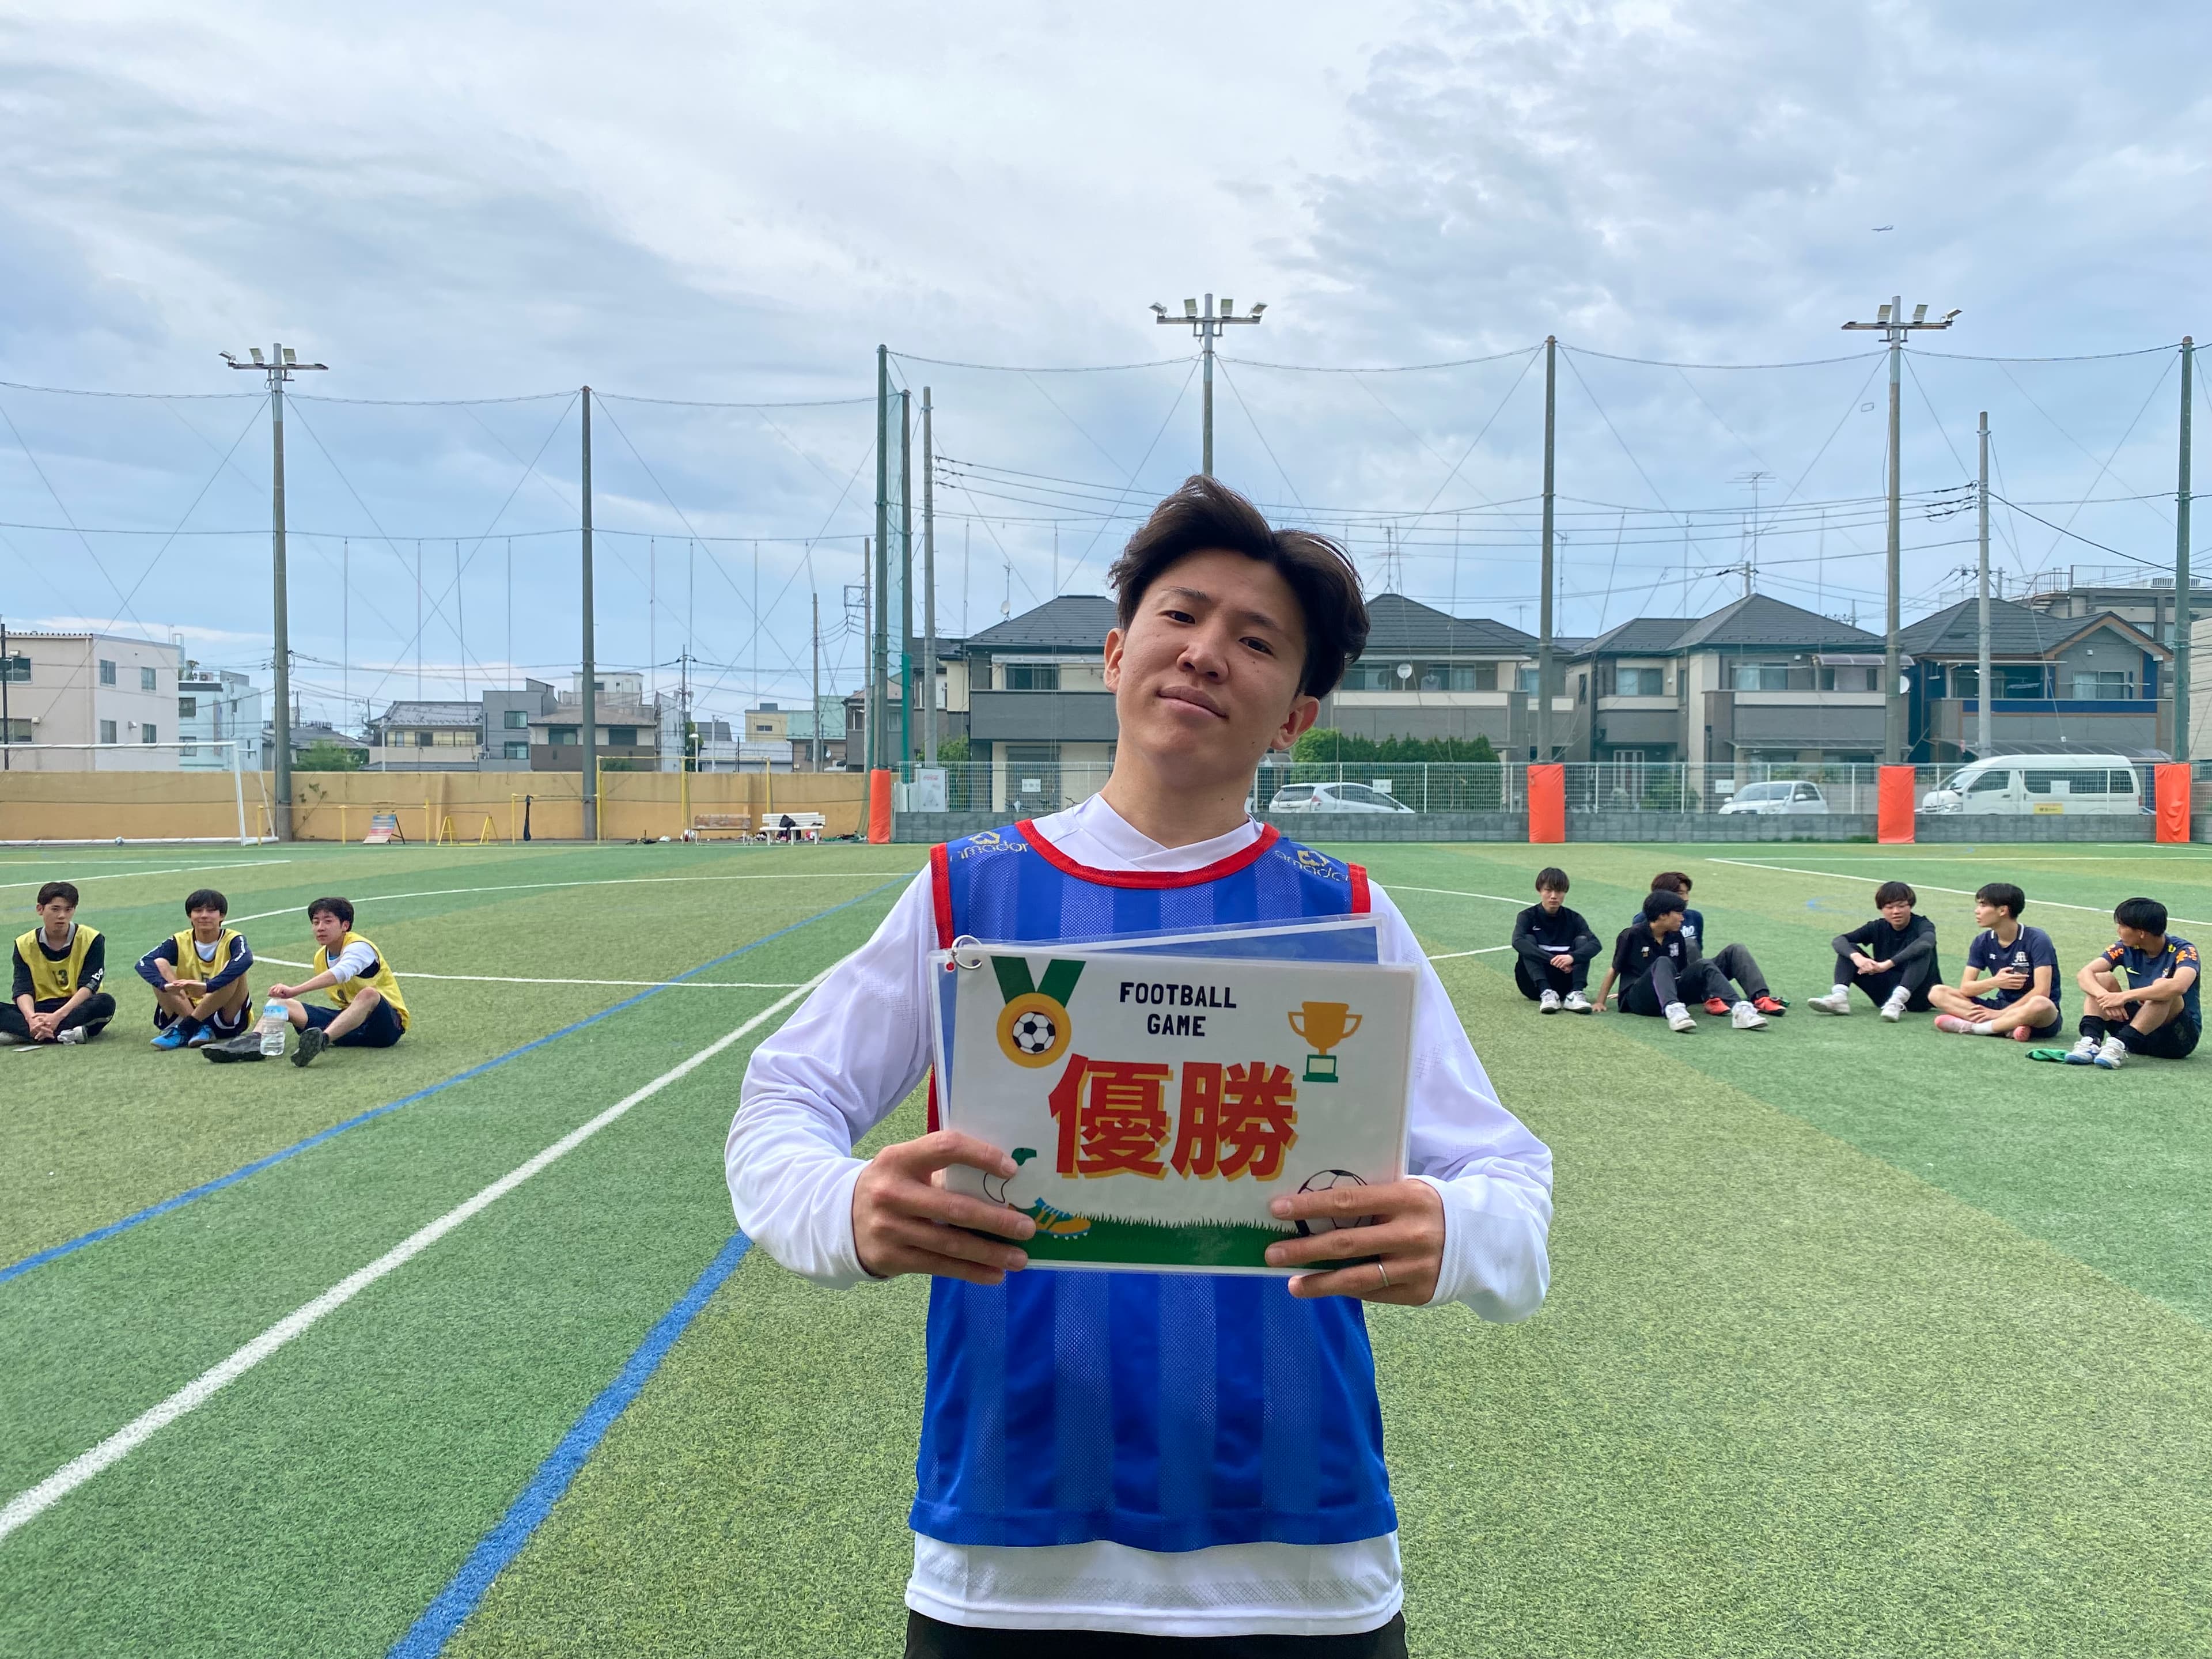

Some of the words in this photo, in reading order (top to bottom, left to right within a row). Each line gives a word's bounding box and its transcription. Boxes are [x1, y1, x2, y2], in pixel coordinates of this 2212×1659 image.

[1120, 982, 1237, 1009] FOOTBALL
[1147, 1013, 1206, 1037] GAME
[1048, 1054, 1298, 1181] 優勝
